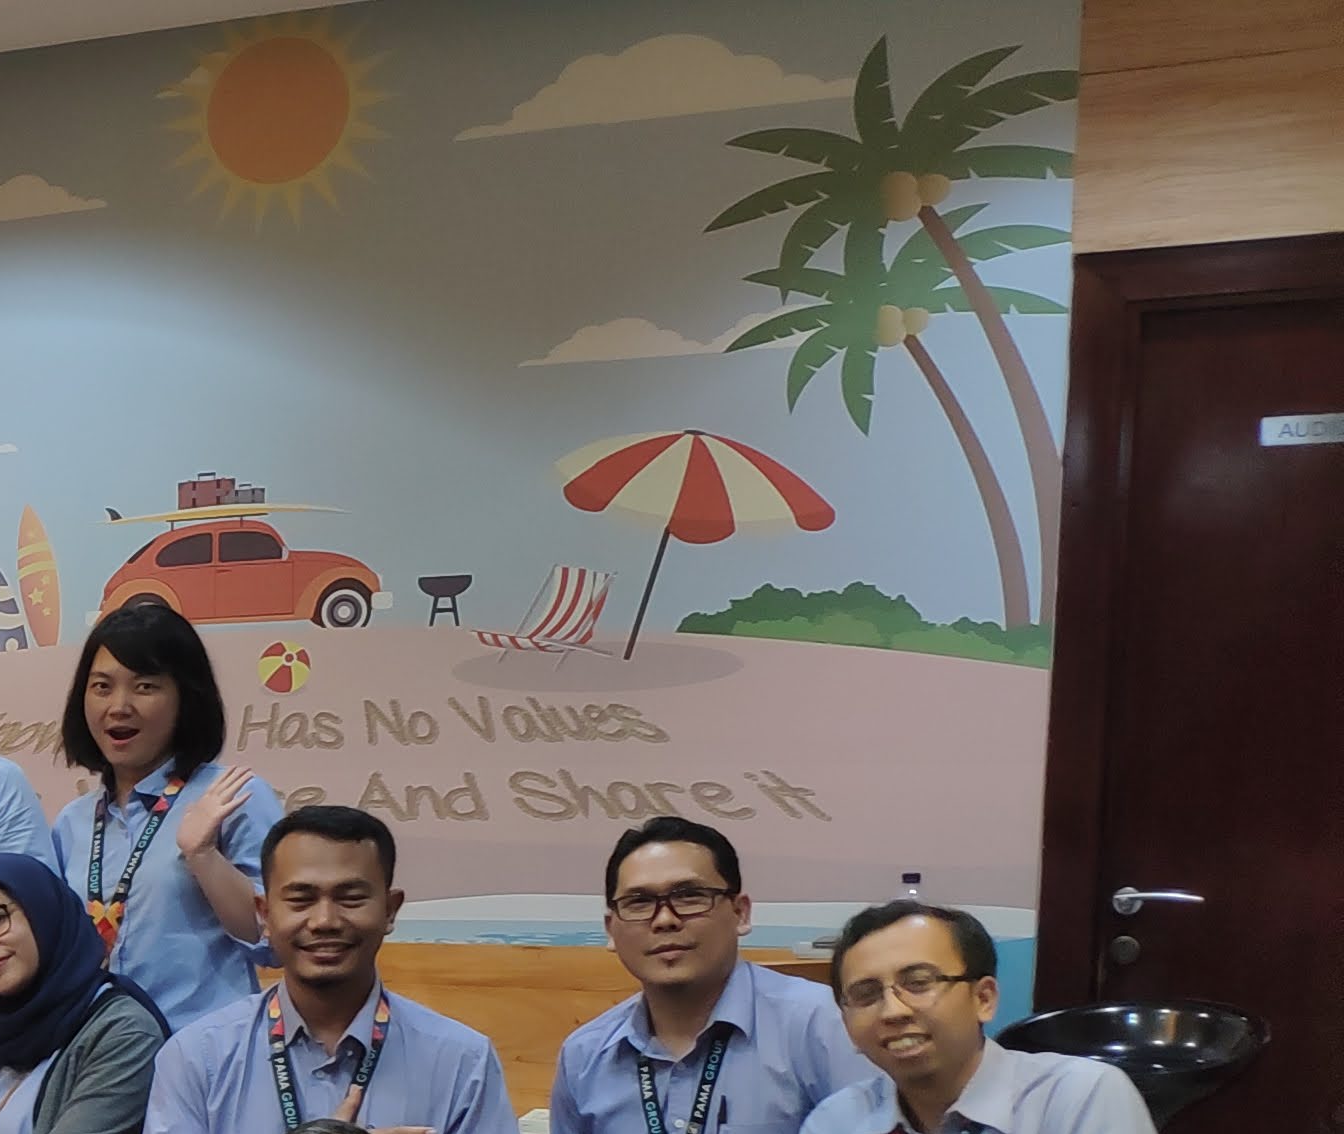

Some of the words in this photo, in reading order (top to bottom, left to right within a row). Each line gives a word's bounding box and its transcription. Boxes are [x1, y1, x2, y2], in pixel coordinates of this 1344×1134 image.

[237, 702, 345, 751] Has
[363, 698, 440, 746] No
[449, 696, 671, 744] Values
[356, 771, 490, 822] And
[508, 769, 757, 822] Share
[743, 769, 833, 822] it
[122, 851, 141, 880] PAMA
[138, 815, 160, 849] GROUP
[274, 1057, 289, 1091] PAMA
[640, 1066, 653, 1099] PAMA
[694, 1080, 711, 1118] PAMA
[705, 1040, 724, 1080] GROUP
